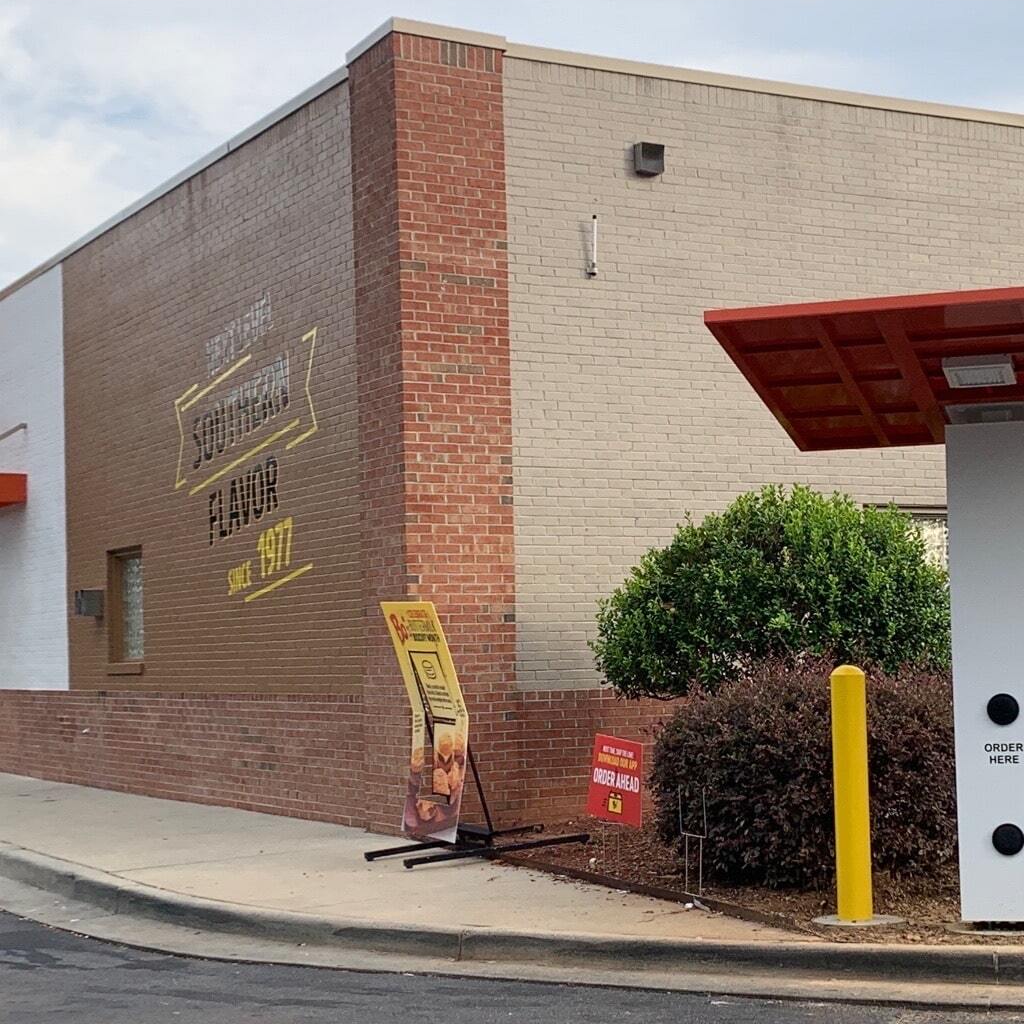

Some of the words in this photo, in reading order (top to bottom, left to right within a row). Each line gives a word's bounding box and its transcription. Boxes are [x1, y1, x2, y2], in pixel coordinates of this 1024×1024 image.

[192, 351, 291, 471] SOUTHERN
[209, 455, 280, 547] FLAVOR
[227, 560, 252, 597] SINCE
[256, 516, 293, 580] 1977
[984, 743, 1024, 753] ORDER
[989, 755, 1020, 764] HERE
[593, 767, 616, 787] ORDER
[615, 772, 640, 793] AHEAD
